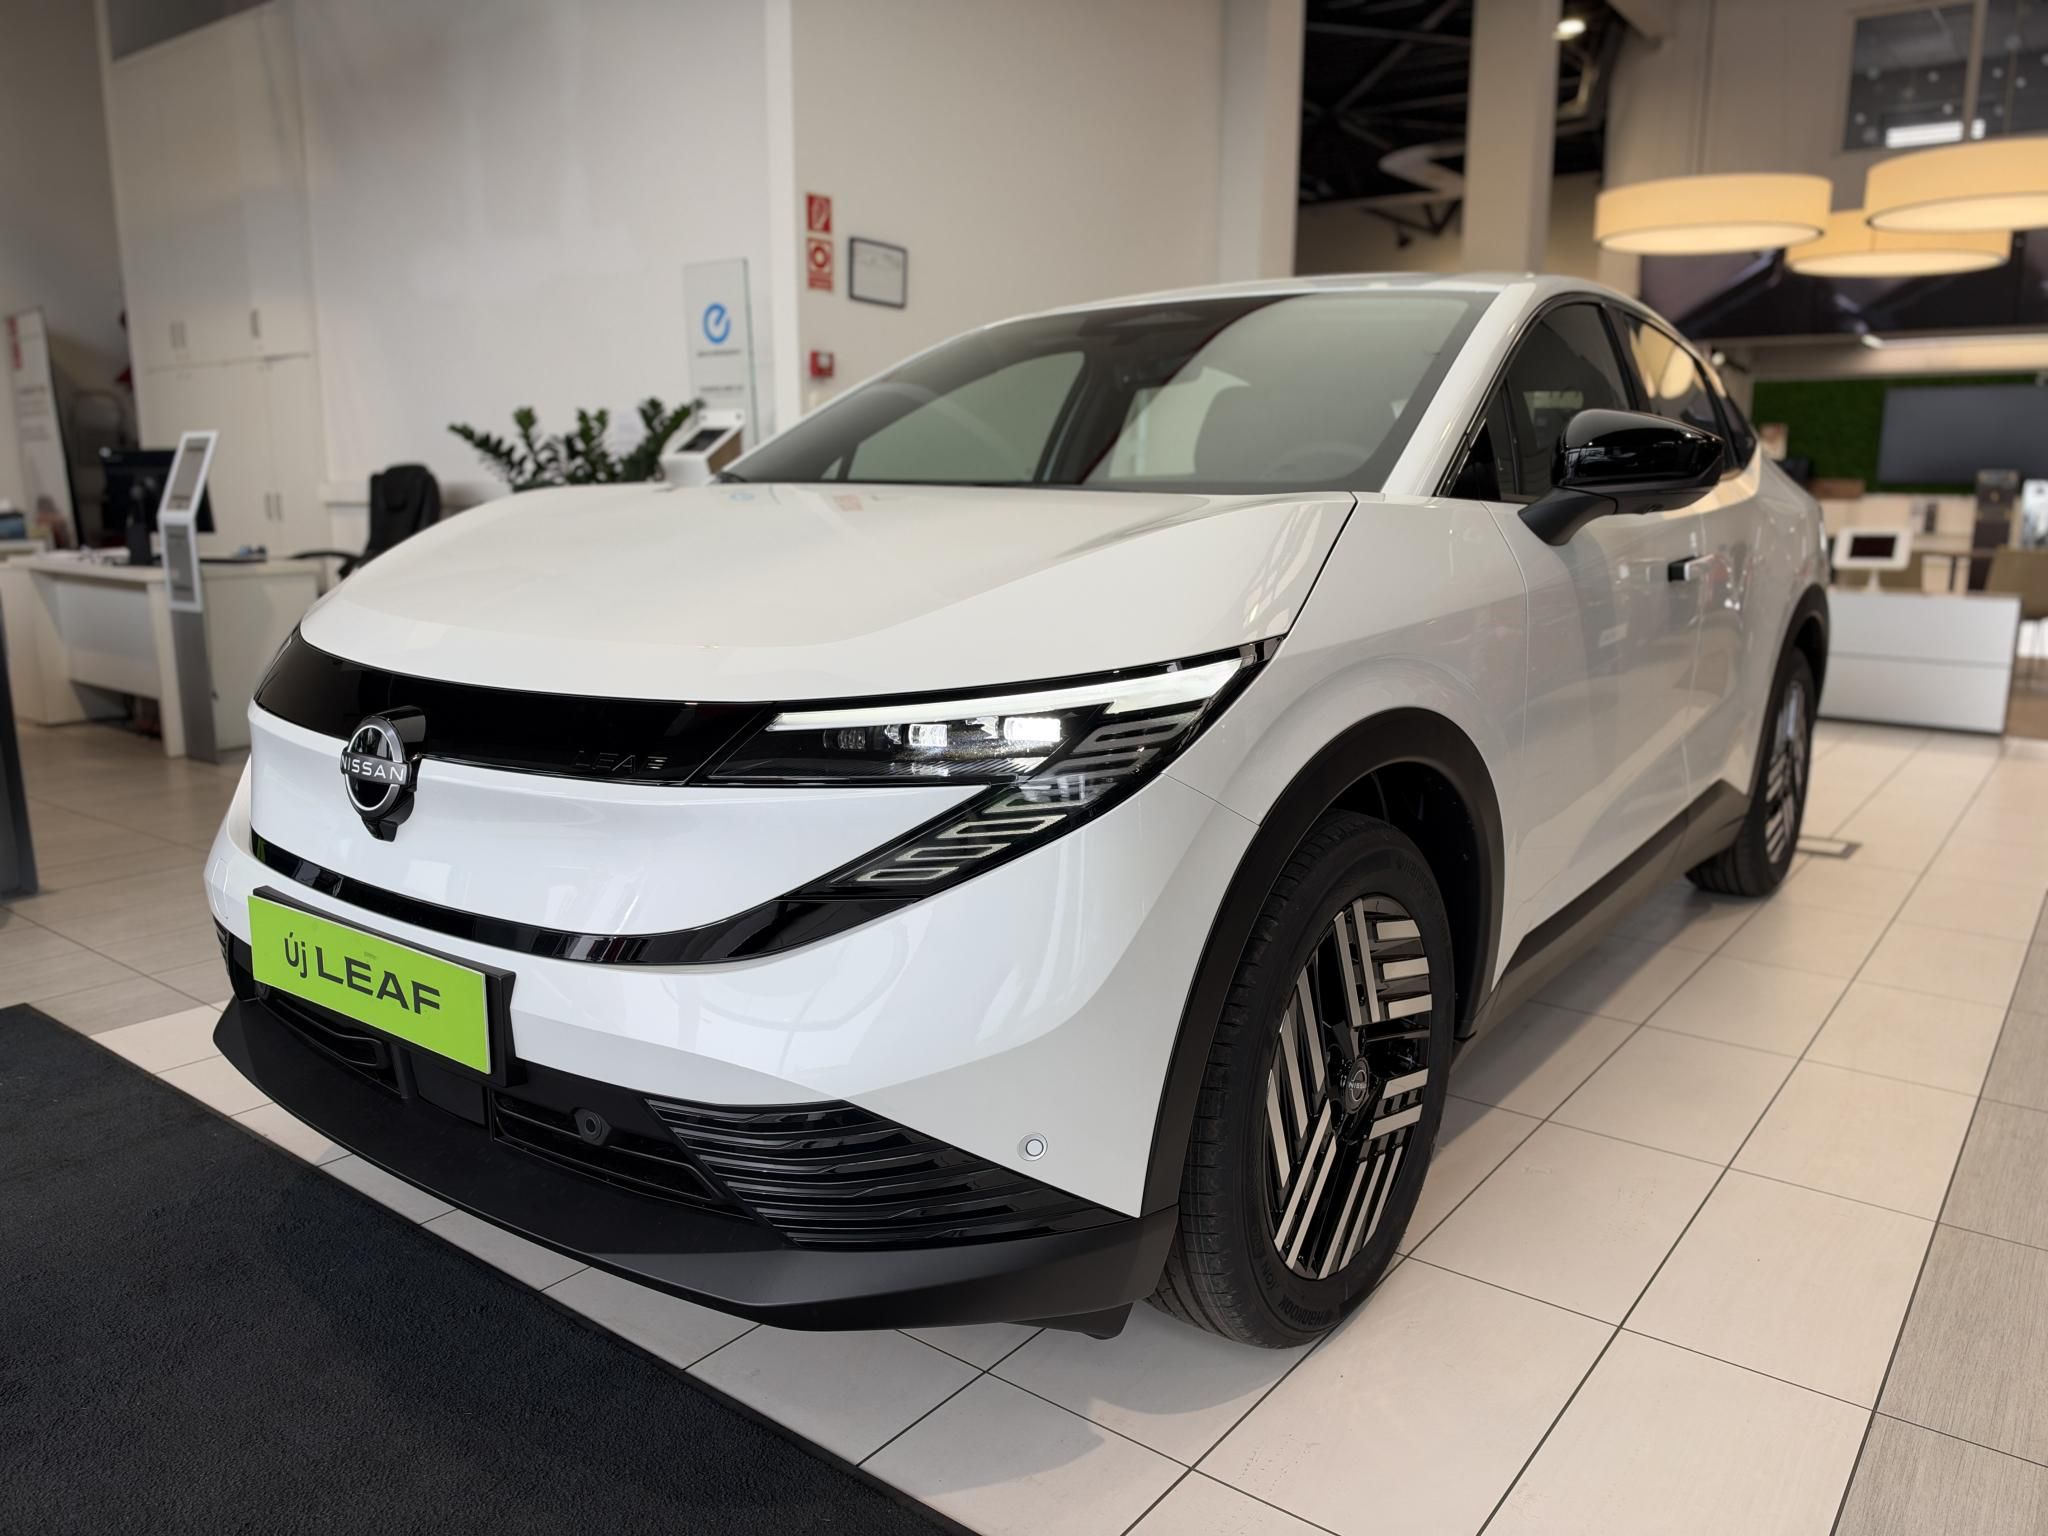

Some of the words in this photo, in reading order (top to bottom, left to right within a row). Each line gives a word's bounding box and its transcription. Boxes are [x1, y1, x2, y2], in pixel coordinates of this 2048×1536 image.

[341, 753, 404, 782] NISSAN
[284, 931, 308, 979] Új
[315, 945, 441, 1015] LEAF
